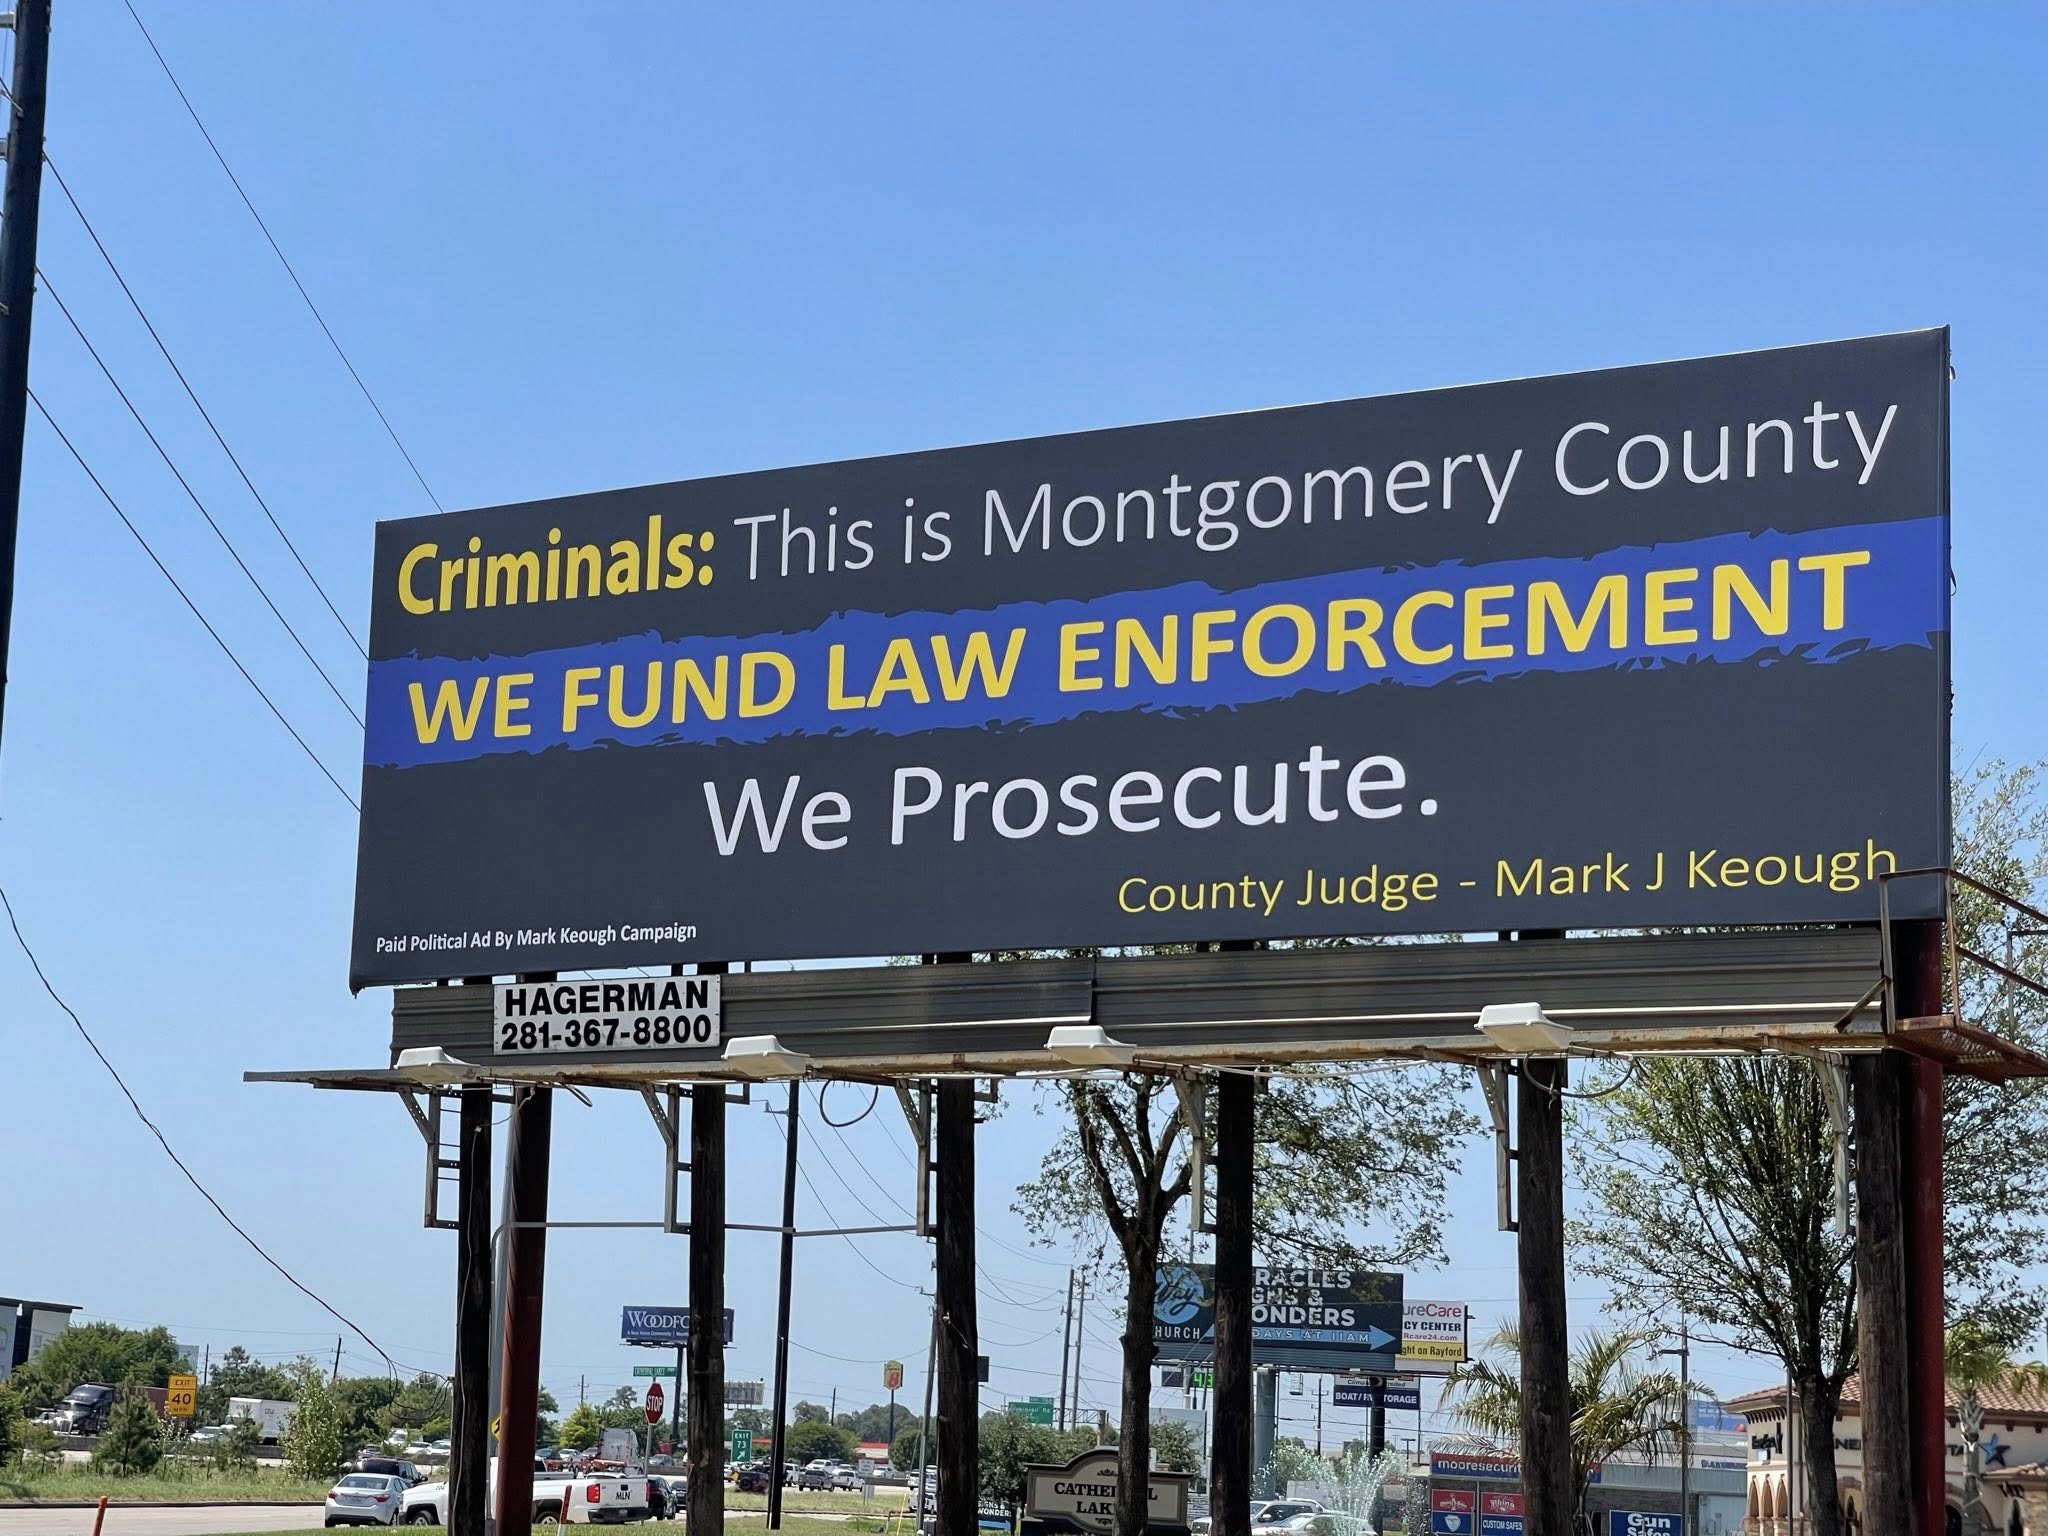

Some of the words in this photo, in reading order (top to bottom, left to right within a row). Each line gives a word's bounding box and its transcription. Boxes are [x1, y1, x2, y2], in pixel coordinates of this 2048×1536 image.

[398, 514, 714, 614] Criminals:
[734, 506, 874, 580] This
[904, 498, 952, 564] is
[984, 449, 1522, 551] Montgomery
[1554, 401, 1898, 496] County
[408, 673, 534, 743] WE
[562, 652, 796, 733] FUND
[828, 628, 1026, 710] LAW
[1058, 550, 1871, 692] ENFORCEMENT
[703, 775, 852, 855] We
[891, 745, 1438, 845] Prosecute.
[1118, 870, 1283, 917] County
[1296, 863, 1440, 910] Judge
[1496, 852, 1631, 896] Mark
[1646, 854, 1663, 890] J
[1687, 838, 1897, 893] Keough
[376, 934, 407, 953] Paid
[411, 932, 467, 951] Political
[471, 931, 491, 948] Ad
[495, 931, 513, 949] By
[517, 928, 556, 946] Mark
[560, 925, 616, 946] Keough
[621, 922, 697, 942] Campaign
[505, 980, 709, 1017] HAGERMAN
[501, 1014, 711, 1050] 281-367-8800
[1256, 1269, 1351, 1289] RACLES
[1252, 1286, 1298, 1305] GNS
[1252, 1305, 1356, 1326] ONDERS
[1403, 1303, 1462, 1318] ureCare
[1154, 1325, 1200, 1340] HURCH
[1420, 1321, 1461, 1331] CENTER
[1252, 1328, 1293, 1339] DAYS
[1303, 1331, 1322, 1340] AT
[1332, 1332, 1369, 1342] 11AM
[1403, 1332, 1458, 1341] Rcare24.com
[1430, 1346, 1462, 1357] Rayford
[172, 1393, 191, 1405] 40
[646, 1395, 663, 1412] STOP
[1384, 1394, 1417, 1404] TORAGE
[737, 1440, 747, 1449] 73
[1438, 1460, 1522, 1473] mooresecurit
[615, 1491, 631, 1500] MLN
[1054, 1482, 1158, 1500] CATHEL
[1076, 1501, 1116, 1515] LAK
[1482, 1519, 1505, 1530] CUSTOM
[1505, 1521, 1523, 1531] SAFES
[1627, 1513, 1671, 1528] Gun
